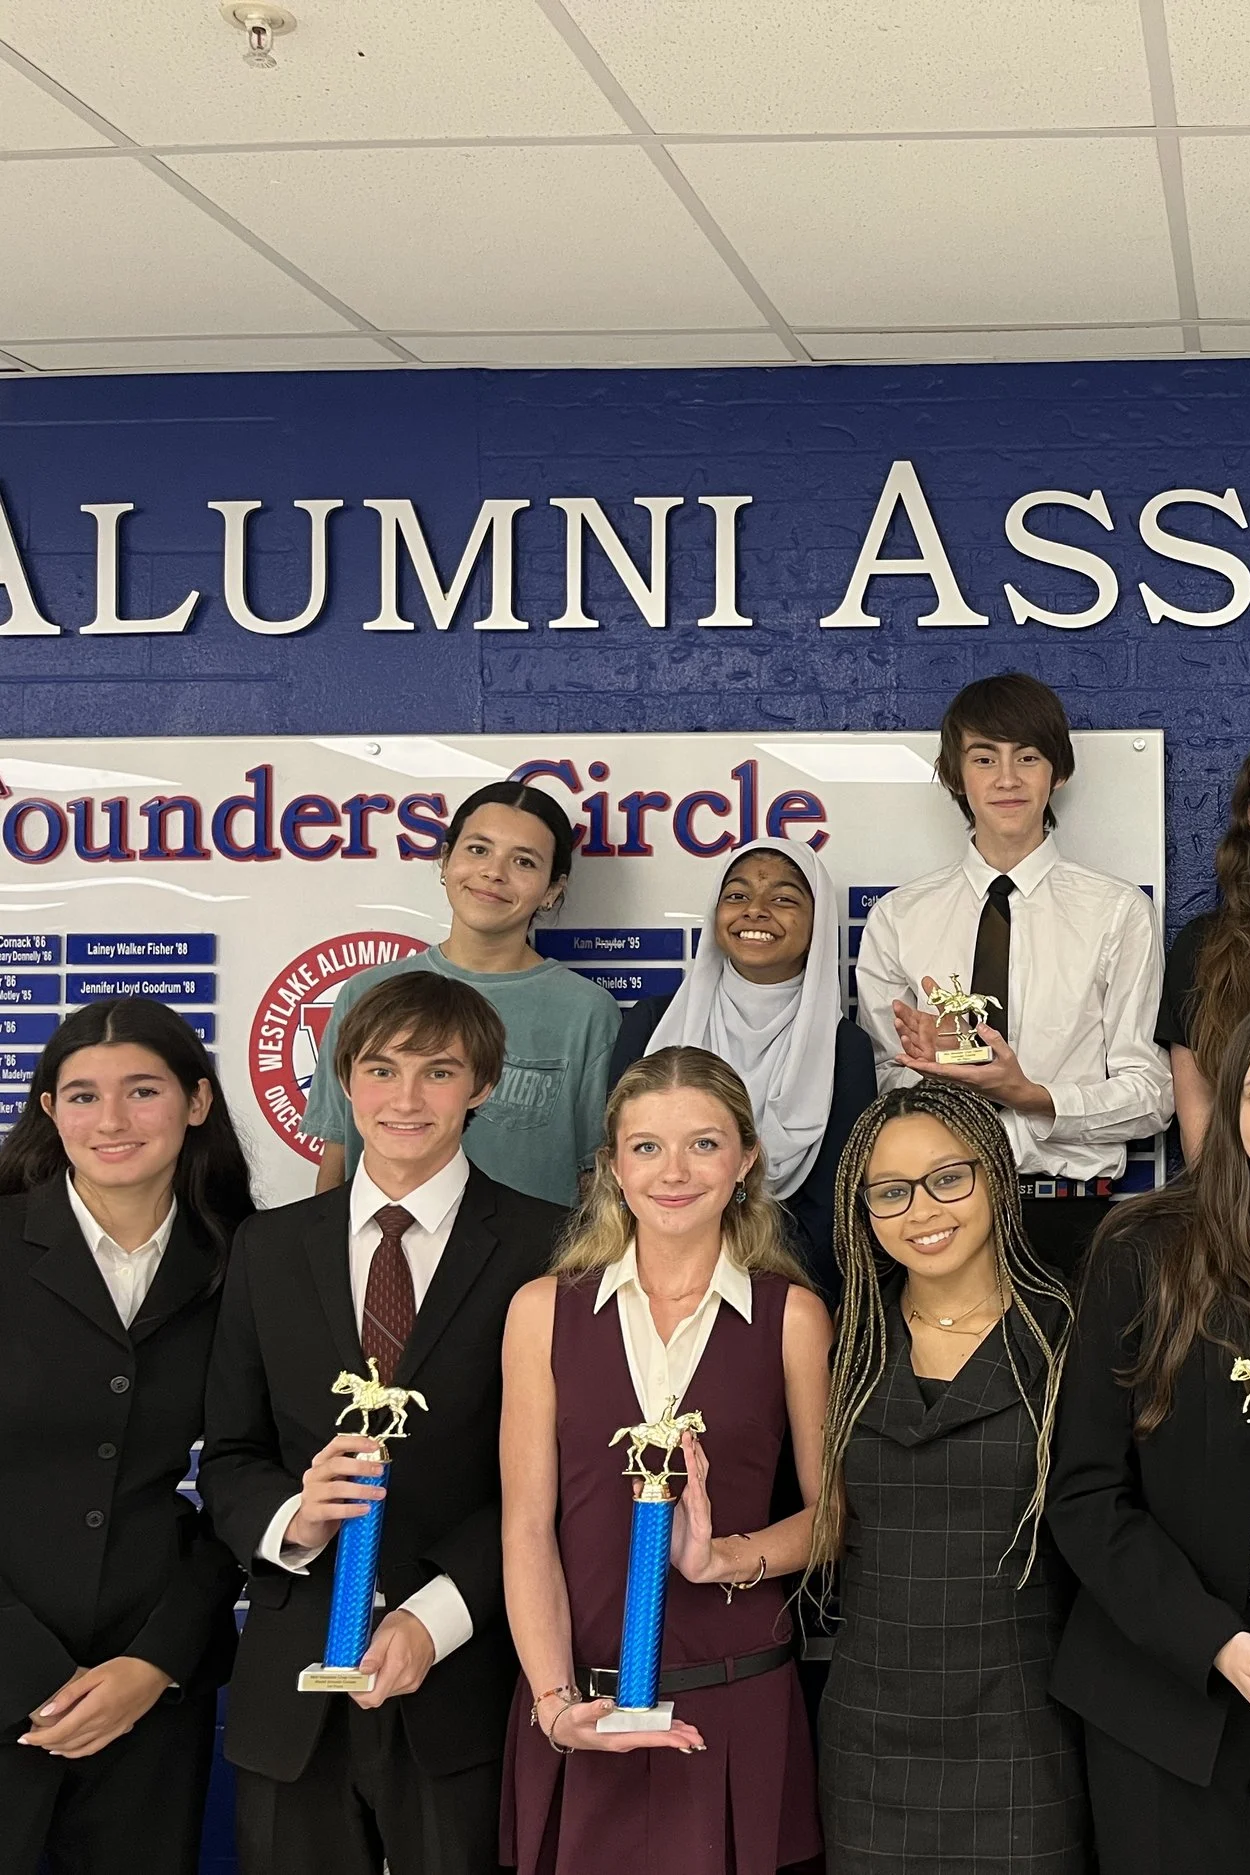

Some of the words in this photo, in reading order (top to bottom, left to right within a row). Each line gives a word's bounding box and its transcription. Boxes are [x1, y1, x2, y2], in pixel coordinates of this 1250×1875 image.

[0, 763, 449, 866] ounders
[33, 936, 46, 948] '86
[573, 936, 593, 949] Kam
[627, 936, 640, 949] '95
[87, 943, 115, 958] Lainey
[117, 943, 145, 955] Walker
[147, 943, 174, 955] Fisher
[175, 943, 188, 955] '88
[80, 981, 114, 994] Jennifer
[116, 981, 140, 997] Lloyd
[142, 981, 181, 994] Goodrum
[182, 981, 195, 994] '88
[596, 976, 627, 989] Shields
[629, 976, 642, 989] '95
[258, 963, 320, 1073] WESTLAKE
[316, 940, 400, 978] ALUMNI
[3, 1020, 16, 1033] '86
[4, 1054, 16, 1066] '86
[264, 1085, 303, 1133] ONCE
